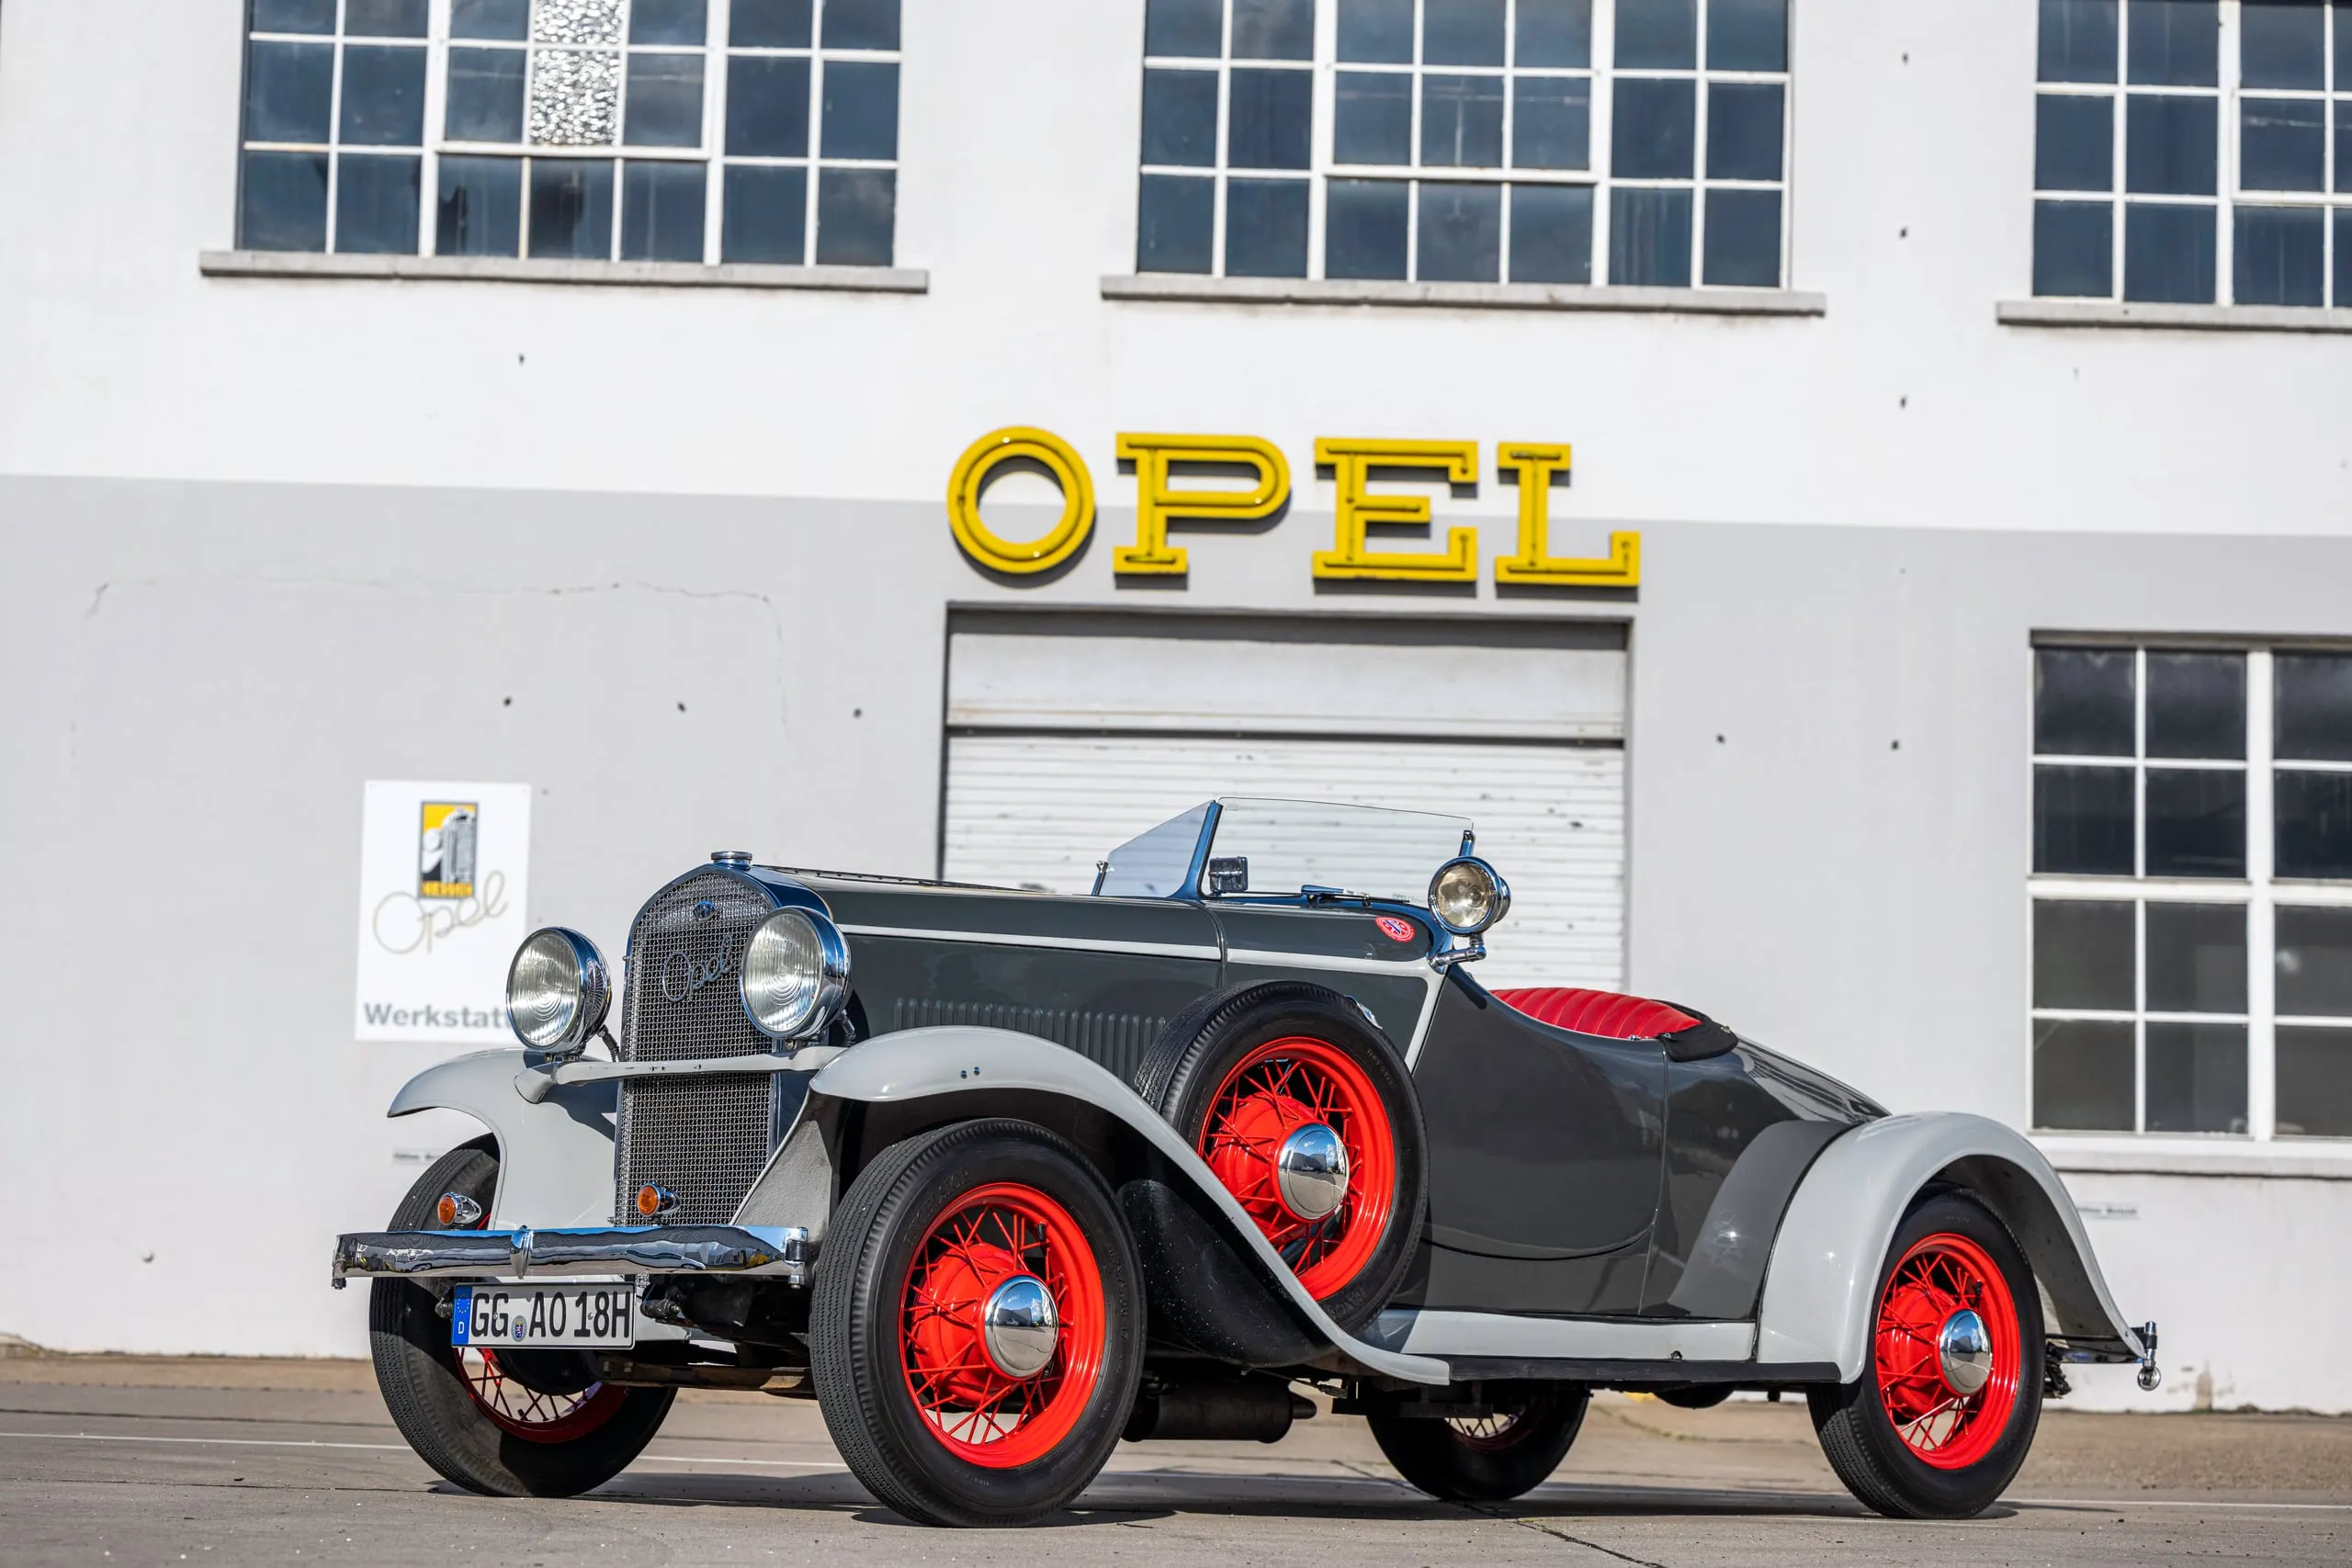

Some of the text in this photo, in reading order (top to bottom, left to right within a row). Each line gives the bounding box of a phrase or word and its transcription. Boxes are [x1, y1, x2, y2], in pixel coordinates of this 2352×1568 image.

[946, 426, 1641, 586] OPEL
[372, 870, 509, 954] Opel
[662, 932, 733, 1003] Opel
[364, 1002, 510, 1030] Werkstat
[458, 1321, 465, 1334] D
[470, 1292, 509, 1337] GG
[573, 1291, 631, 1337] 18H
